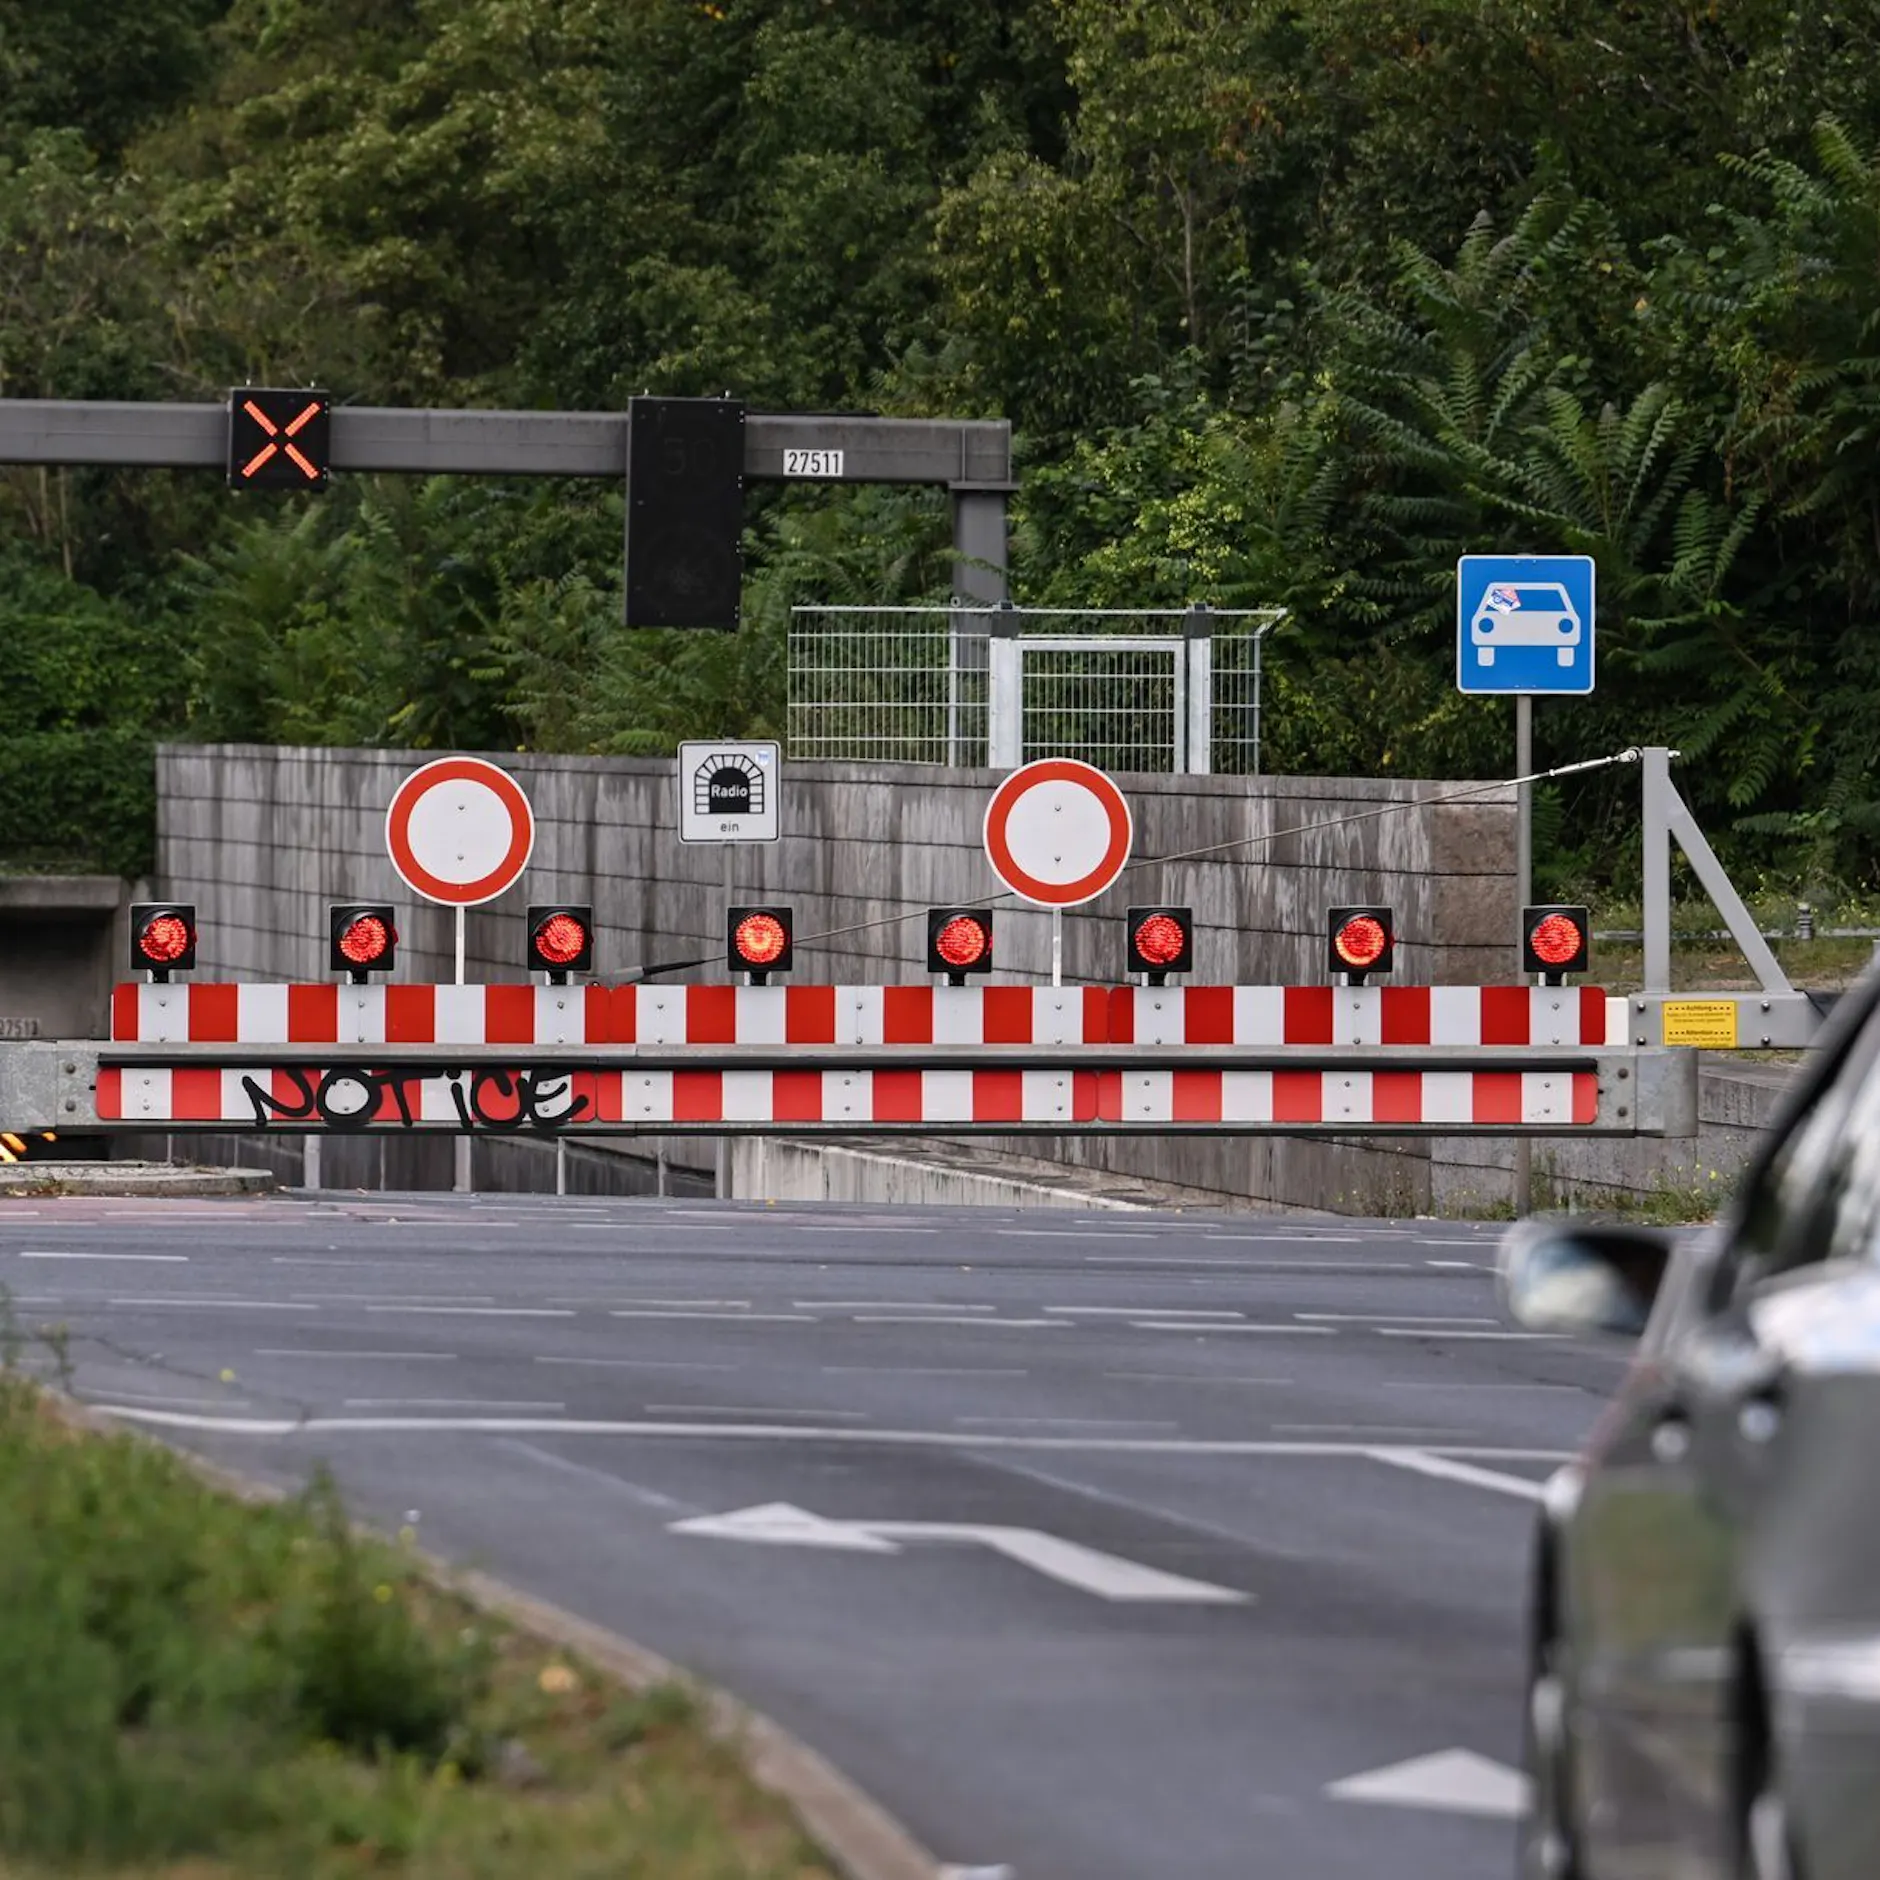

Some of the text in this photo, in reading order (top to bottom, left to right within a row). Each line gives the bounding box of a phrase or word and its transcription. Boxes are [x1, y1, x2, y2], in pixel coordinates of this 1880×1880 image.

[788, 451, 839, 474] 27511
[710, 784, 748, 798] Radio
[720, 822, 740, 833] ein
